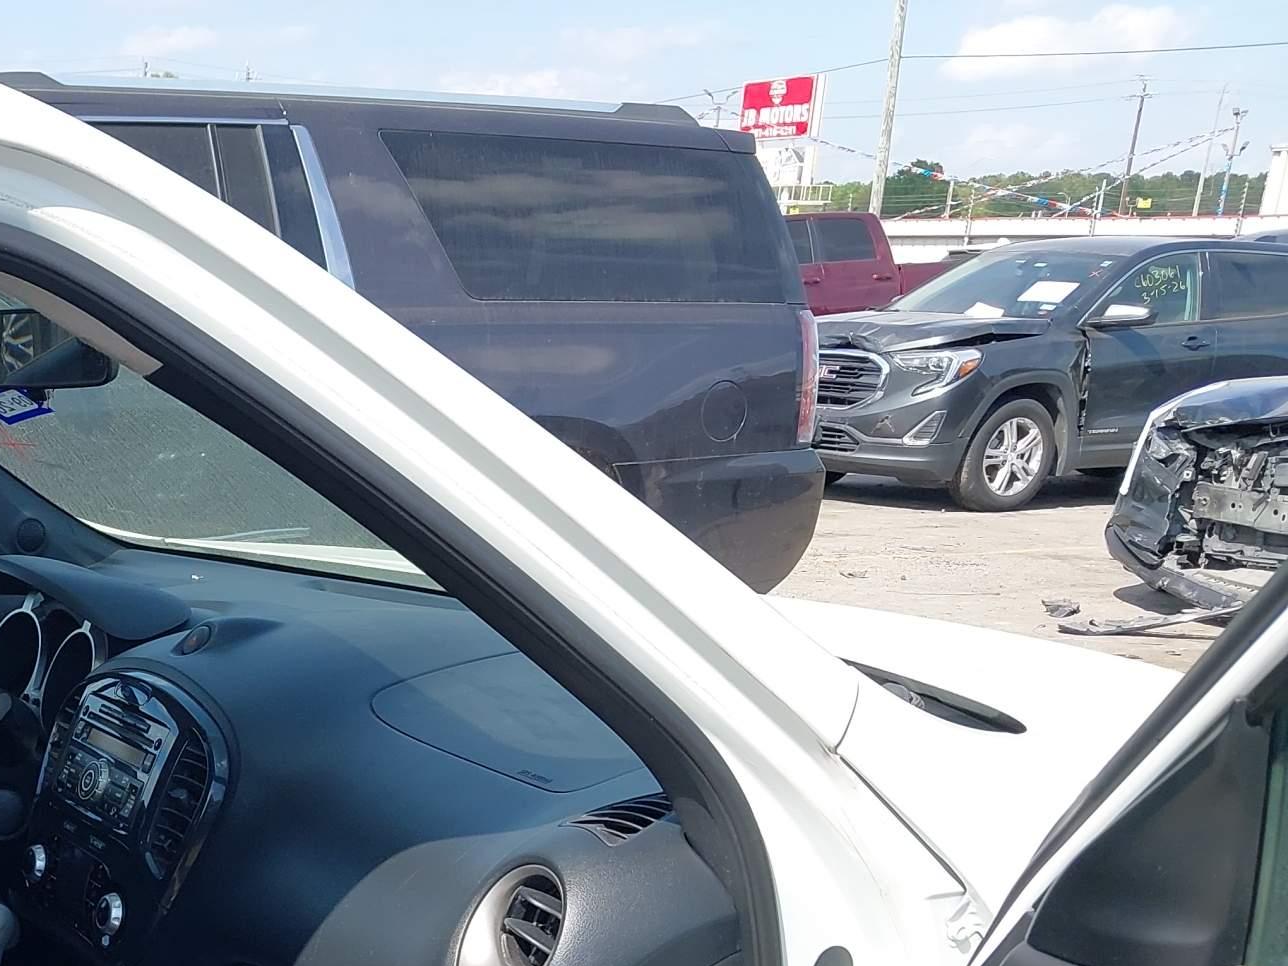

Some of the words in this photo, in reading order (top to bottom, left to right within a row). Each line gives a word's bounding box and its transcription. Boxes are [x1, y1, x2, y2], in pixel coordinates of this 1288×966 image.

[742, 109, 756, 127] JB
[759, 104, 809, 124] MOTORS
[1140, 280, 1186, 305] 3-15-26
